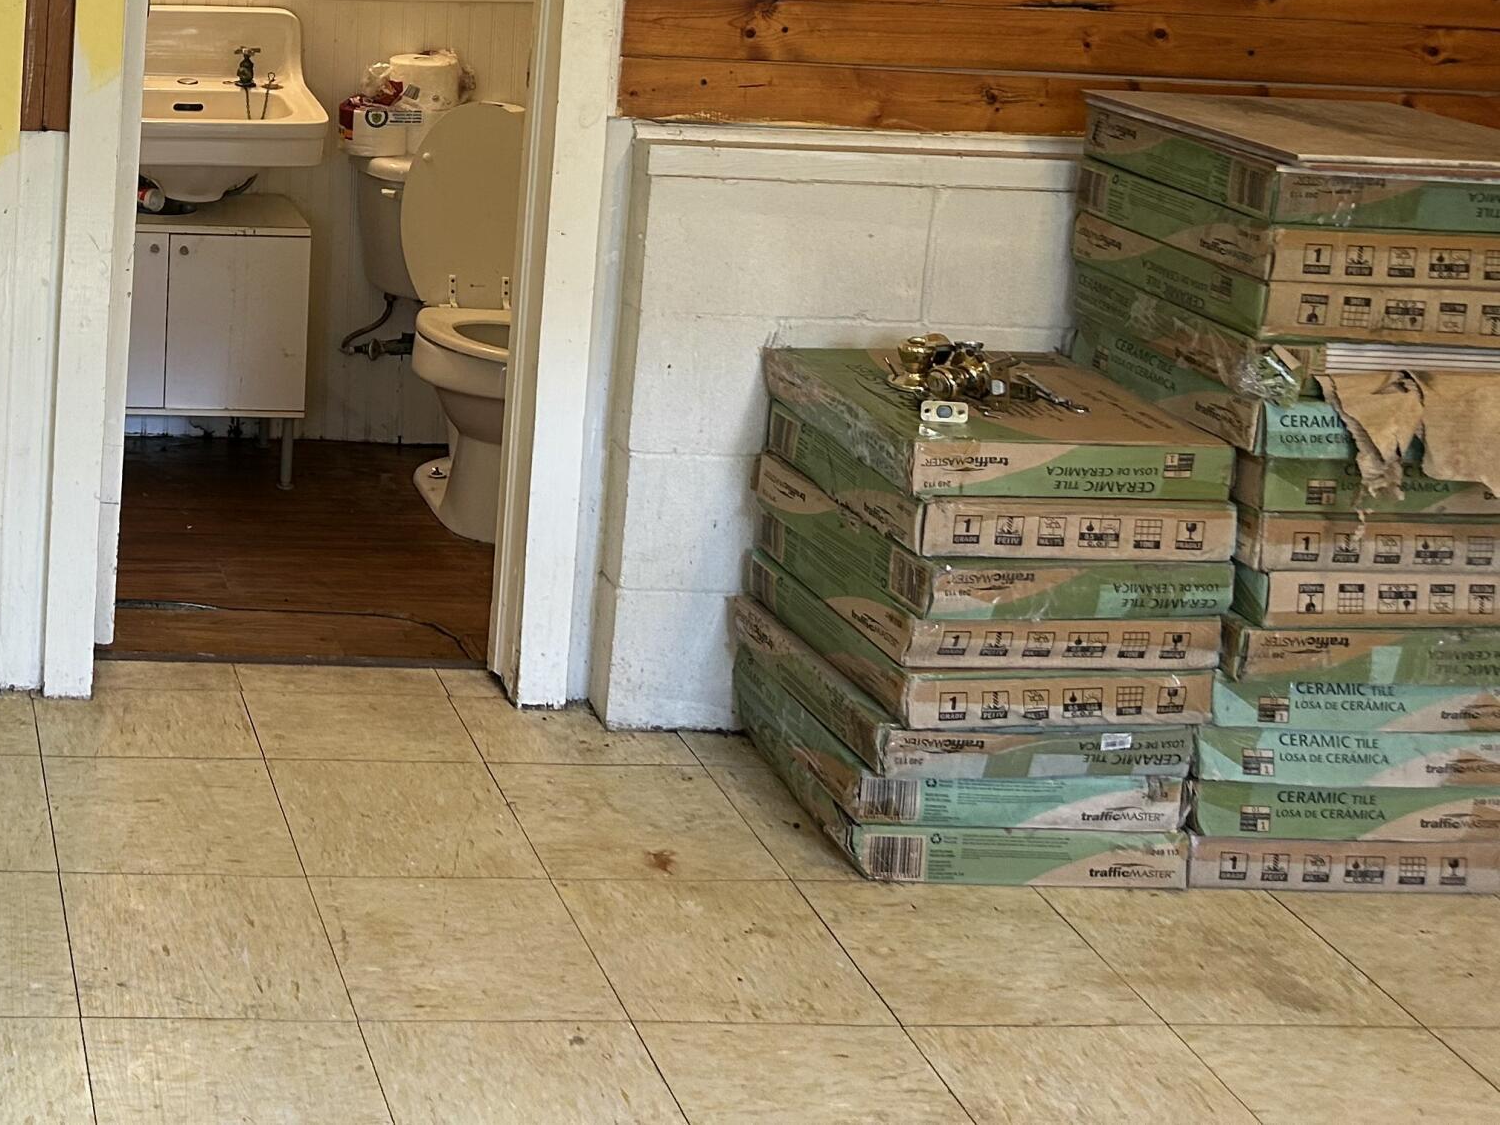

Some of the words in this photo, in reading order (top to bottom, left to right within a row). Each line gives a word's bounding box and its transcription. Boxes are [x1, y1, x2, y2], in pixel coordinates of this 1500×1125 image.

[1280, 414, 1343, 428] CERAMI
[1310, 435, 1323, 444] DE
[1118, 466, 1132, 476] DE
[1136, 466, 1158, 476] LOSA
[1053, 480, 1079, 490] TILE
[1084, 480, 1156, 493] CERAMIC
[963, 518, 972, 533] 1
[1302, 536, 1310, 551] 1
[1120, 597, 1145, 608] TILE
[1150, 597, 1217, 609] CERAMIC
[1296, 682, 1366, 696] CERAMIC
[1371, 684, 1396, 696] TILE
[949, 696, 958, 710] 1
[1295, 700, 1321, 710] LOSA
[1325, 700, 1339, 711] DE
[1279, 733, 1351, 749] CERAMIC
[1356, 738, 1379, 749] TILE
[1083, 753, 1108, 764] TILE
[1111, 753, 1182, 765] CERAMIC
[1279, 753, 1306, 763] LOSA
[1309, 753, 1323, 763] DE
[1277, 790, 1347, 805] CERAMIC
[1352, 794, 1376, 805] TILE
[1276, 809, 1301, 819] LOSA
[1304, 809, 1318, 819] DE
[1089, 866, 1174, 878] trafficMASTER
